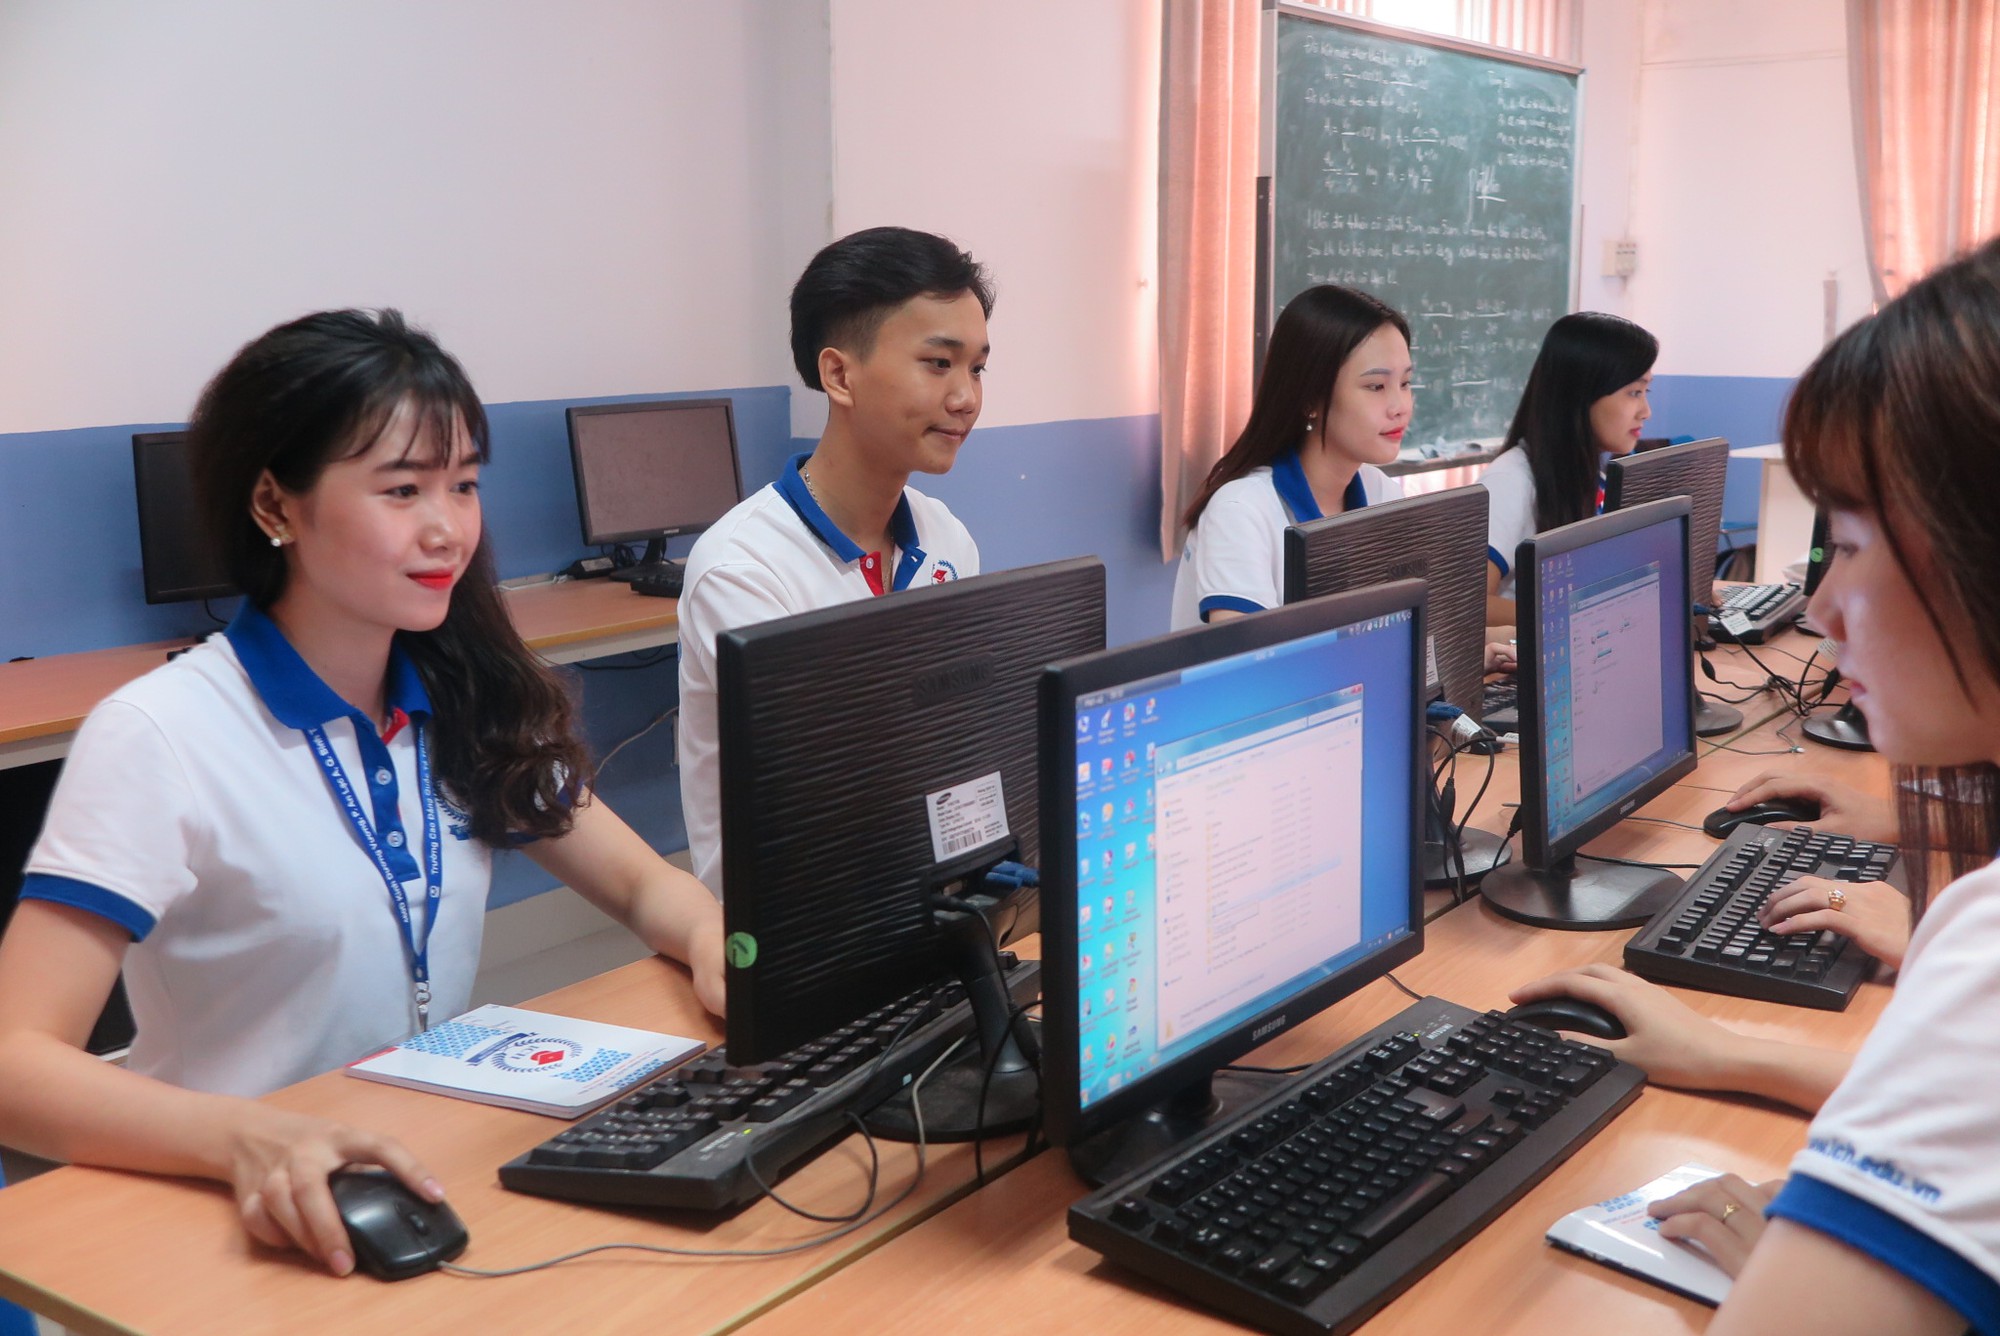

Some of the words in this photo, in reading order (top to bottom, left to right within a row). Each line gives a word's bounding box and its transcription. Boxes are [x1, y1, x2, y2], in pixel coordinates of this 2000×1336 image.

[345, 794, 356, 807] An
[428, 821, 438, 840] Cao
[390, 880, 404, 902] Kinh
